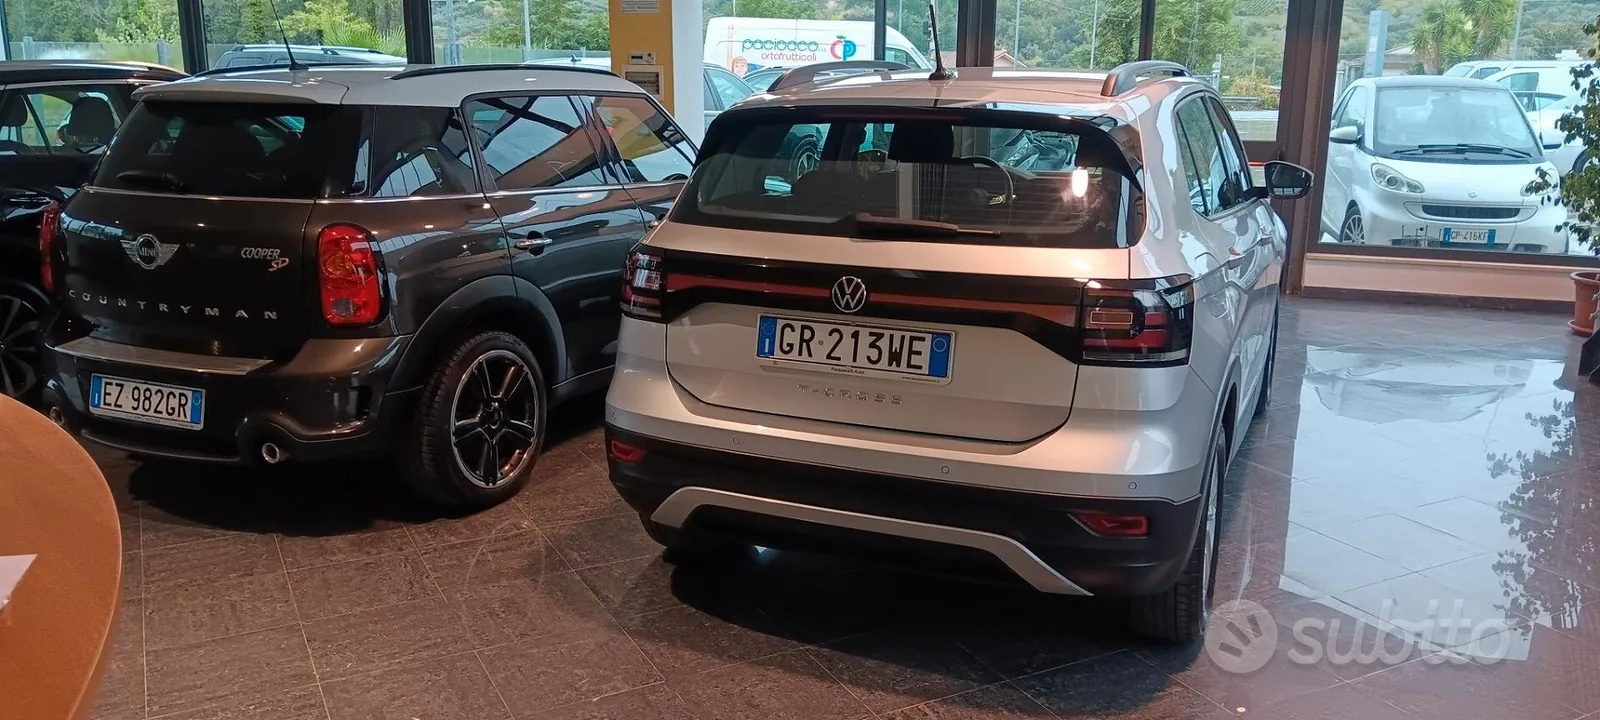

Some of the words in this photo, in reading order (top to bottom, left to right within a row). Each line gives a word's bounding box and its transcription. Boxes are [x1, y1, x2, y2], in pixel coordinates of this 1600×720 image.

[761, 52, 817, 61] ortofrutticoli
[241, 247, 281, 260] COOPER
[268, 257, 289, 272] SD
[69, 289, 278, 320] COUNTRYMAN
[779, 323, 816, 358] GR
[825, 327, 926, 370] 213WE
[103, 381, 125, 409] EZ
[131, 386, 189, 419] 982GR
[797, 384, 903, 405] T-CROSS
